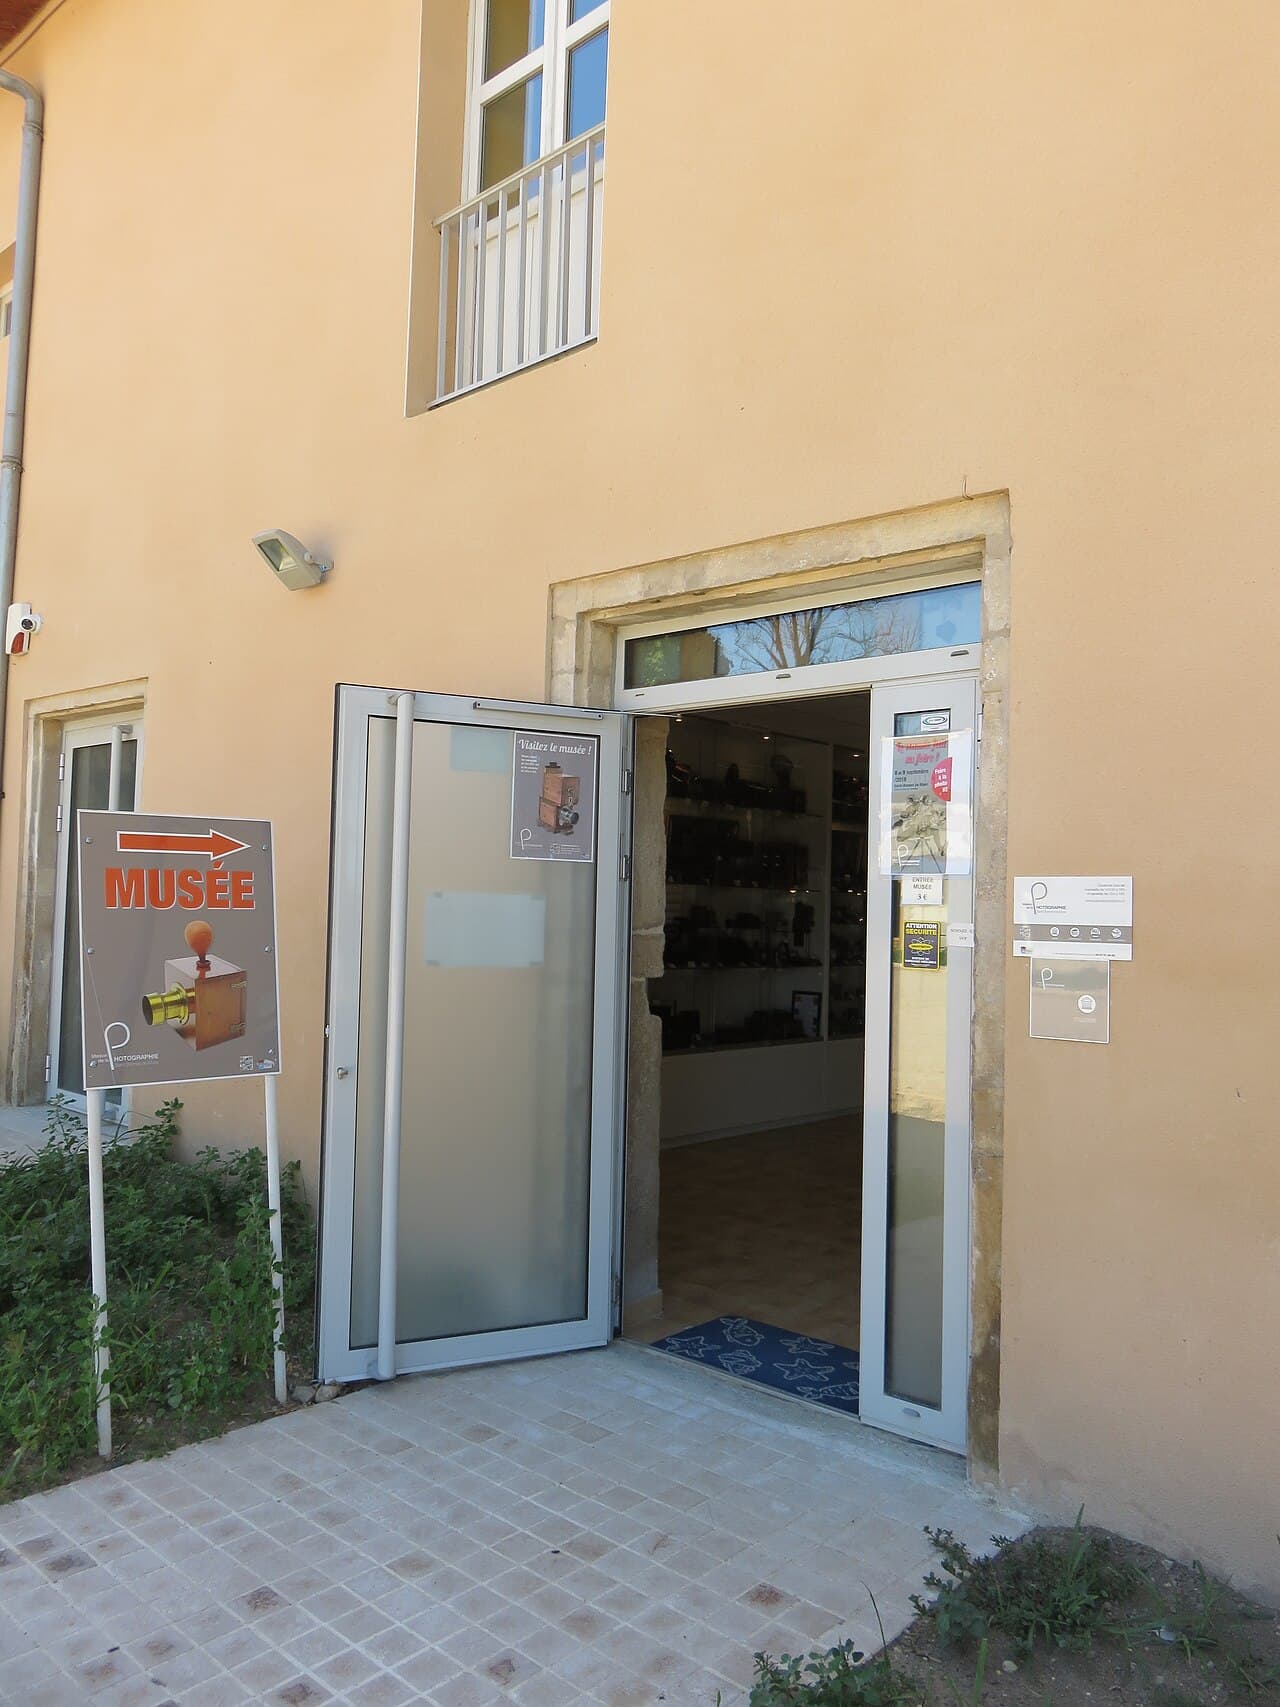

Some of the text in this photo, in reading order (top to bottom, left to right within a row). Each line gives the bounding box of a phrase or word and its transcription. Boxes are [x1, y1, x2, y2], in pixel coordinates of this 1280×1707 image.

[519, 739, 592, 755] Visitez le musée !
[104, 861, 256, 910] MUSÉE
